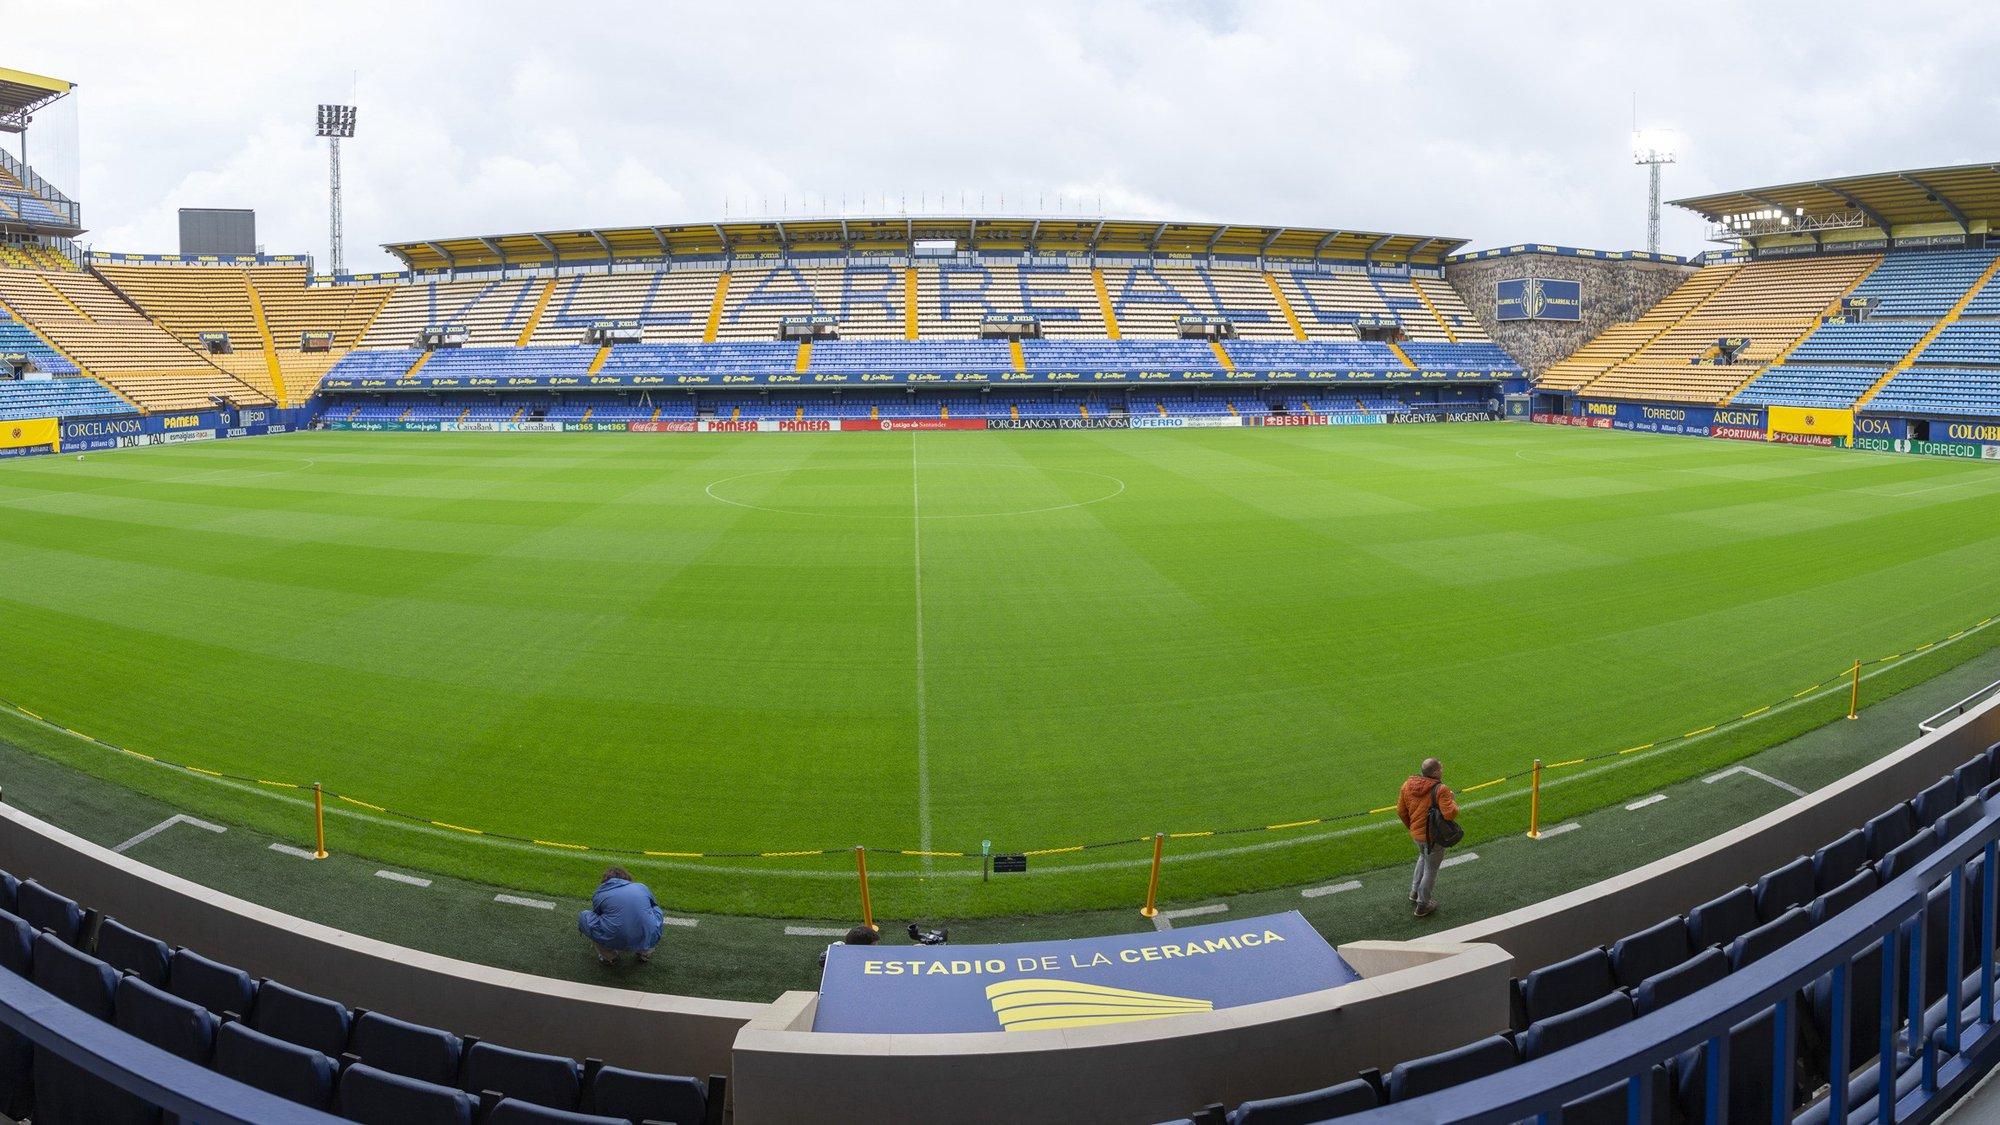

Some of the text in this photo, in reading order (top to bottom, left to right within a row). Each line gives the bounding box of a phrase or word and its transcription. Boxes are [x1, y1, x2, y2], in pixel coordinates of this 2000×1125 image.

[1588, 403, 1617, 415] PAMES
[1642, 406, 1685, 420] TORRECID
[164, 415, 199, 428] PAMESA
[1142, 418, 1183, 427] FERRO
[1277, 416, 1327, 425] BESTILE
[1393, 412, 1490, 423] ARGENTA ARGENTA
[1713, 411, 1759, 425] ARGENT
[457, 422, 556, 431] CaixaBank CaixaBank
[565, 423, 626, 431] bet365 bet365
[708, 420, 830, 431] PAMESA PAMESA
[987, 418, 1130, 429] PORCELANOSA PORCELANOSA
[1918, 441, 1975, 457] TORRECID
[864, 930, 1285, 976] ESTADIO DE LA CERAMICA
